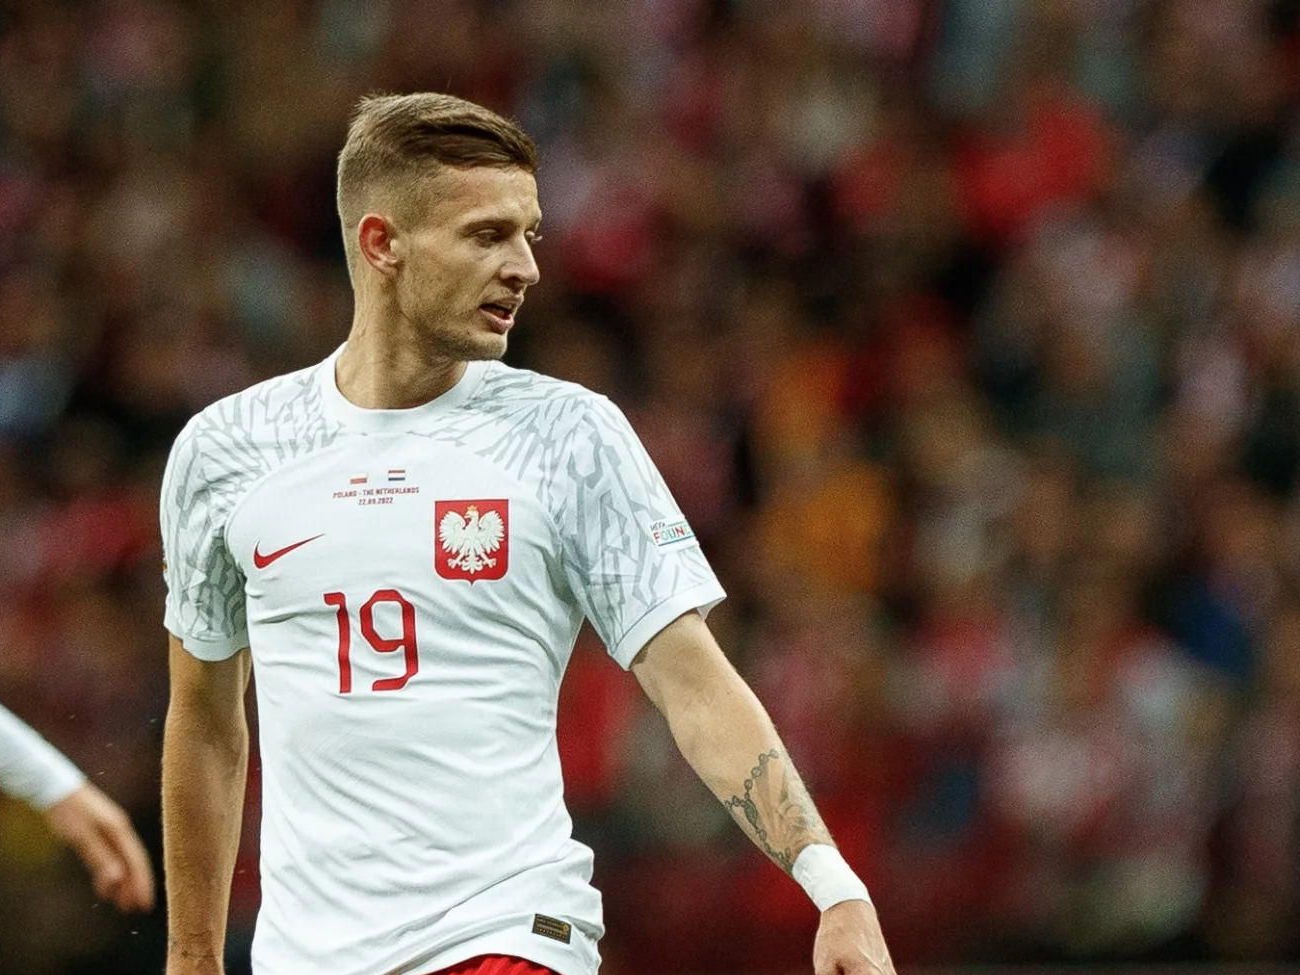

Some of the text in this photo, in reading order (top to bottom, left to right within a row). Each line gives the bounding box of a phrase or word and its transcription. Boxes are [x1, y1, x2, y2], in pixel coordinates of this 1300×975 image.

[333, 490, 357, 499] POLAND
[363, 489, 374, 497] THE
[375, 487, 420, 496] NETHERLANDS
[323, 589, 419, 693] 19
